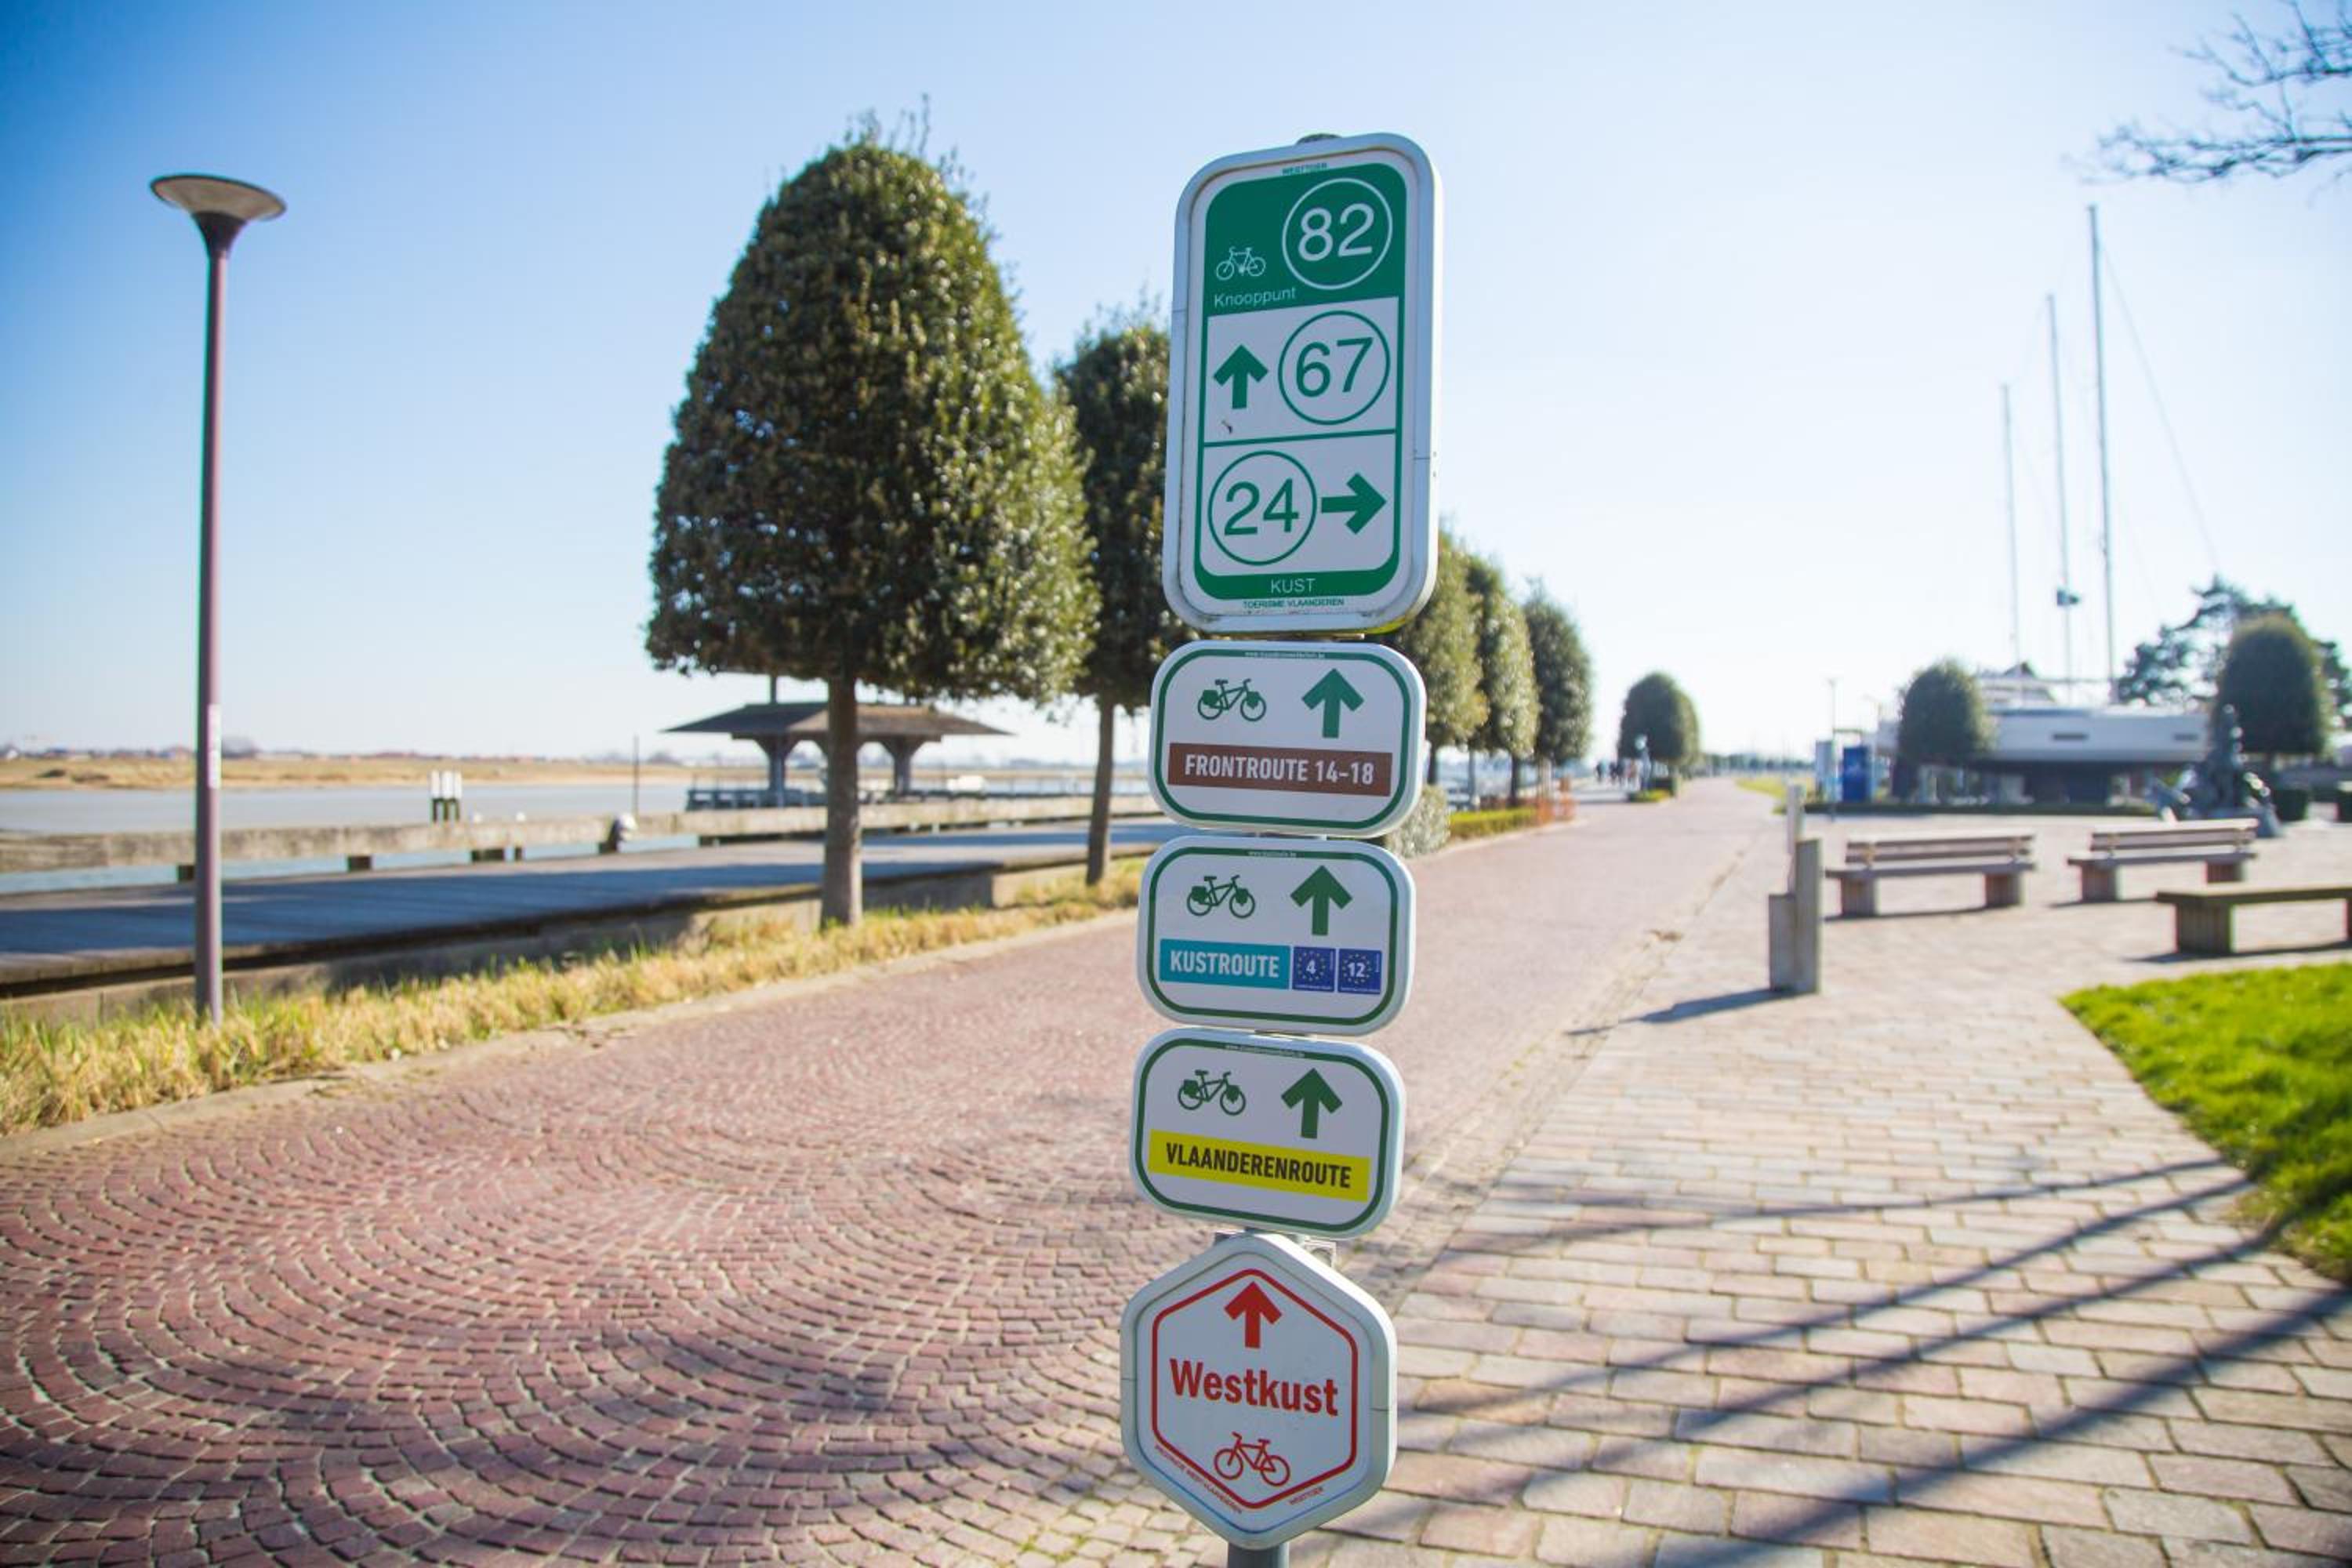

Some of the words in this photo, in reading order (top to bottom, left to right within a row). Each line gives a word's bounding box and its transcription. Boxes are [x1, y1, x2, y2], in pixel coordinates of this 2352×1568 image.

[1298, 203, 1374, 262] 82
[1214, 288, 1296, 307] Knooppunt
[1295, 337, 1374, 397] 67
[1224, 477, 1299, 535] 24
[1270, 578, 1316, 593] KUST
[1185, 753, 1308, 782] FRONTROUTE
[1316, 760, 1374, 785] 14-18
[1170, 950, 1279, 978] KUSTROUTE
[1305, 959, 1317, 975] 4
[1348, 962, 1367, 978] 12
[1166, 1142, 1352, 1189] VLAANDERENROUTE
[1169, 1358, 1338, 1417] Westkust
